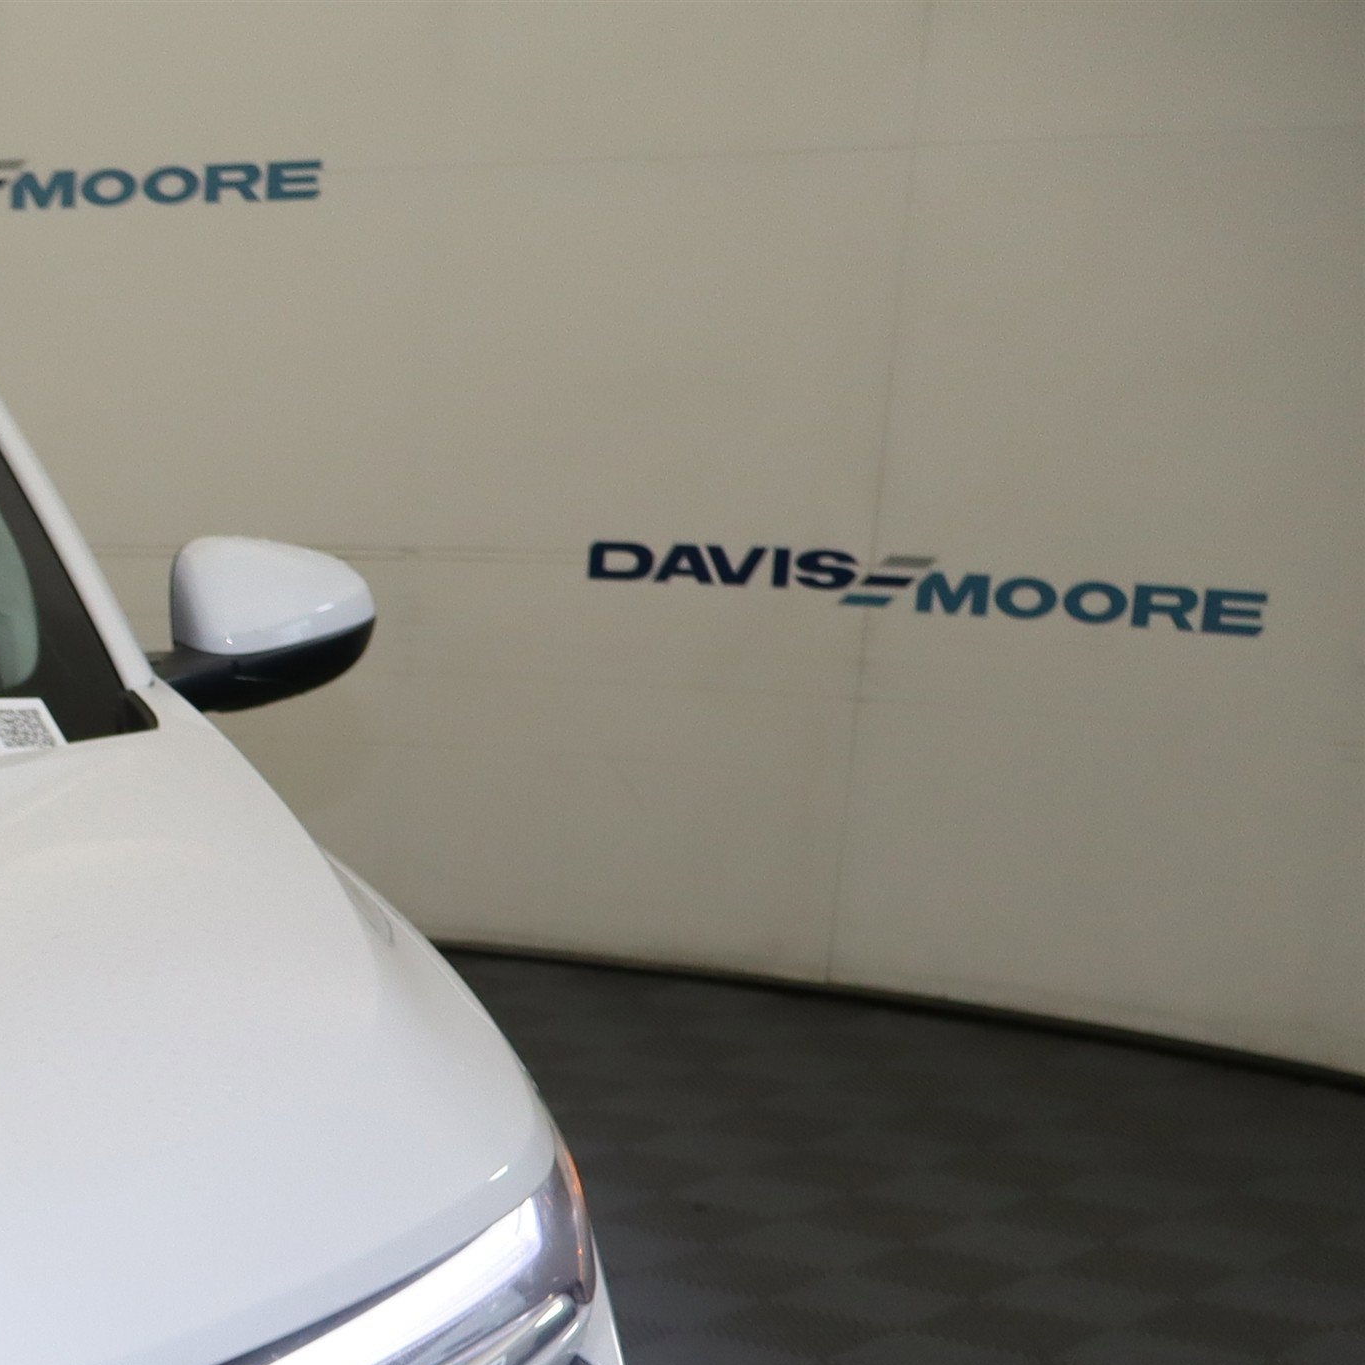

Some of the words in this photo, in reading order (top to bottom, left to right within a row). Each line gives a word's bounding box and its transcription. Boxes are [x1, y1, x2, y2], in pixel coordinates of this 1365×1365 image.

[10, 160, 322, 210] MOORE
[587, 541, 857, 591] DAVIS
[915, 572, 1268, 637] MOORE
